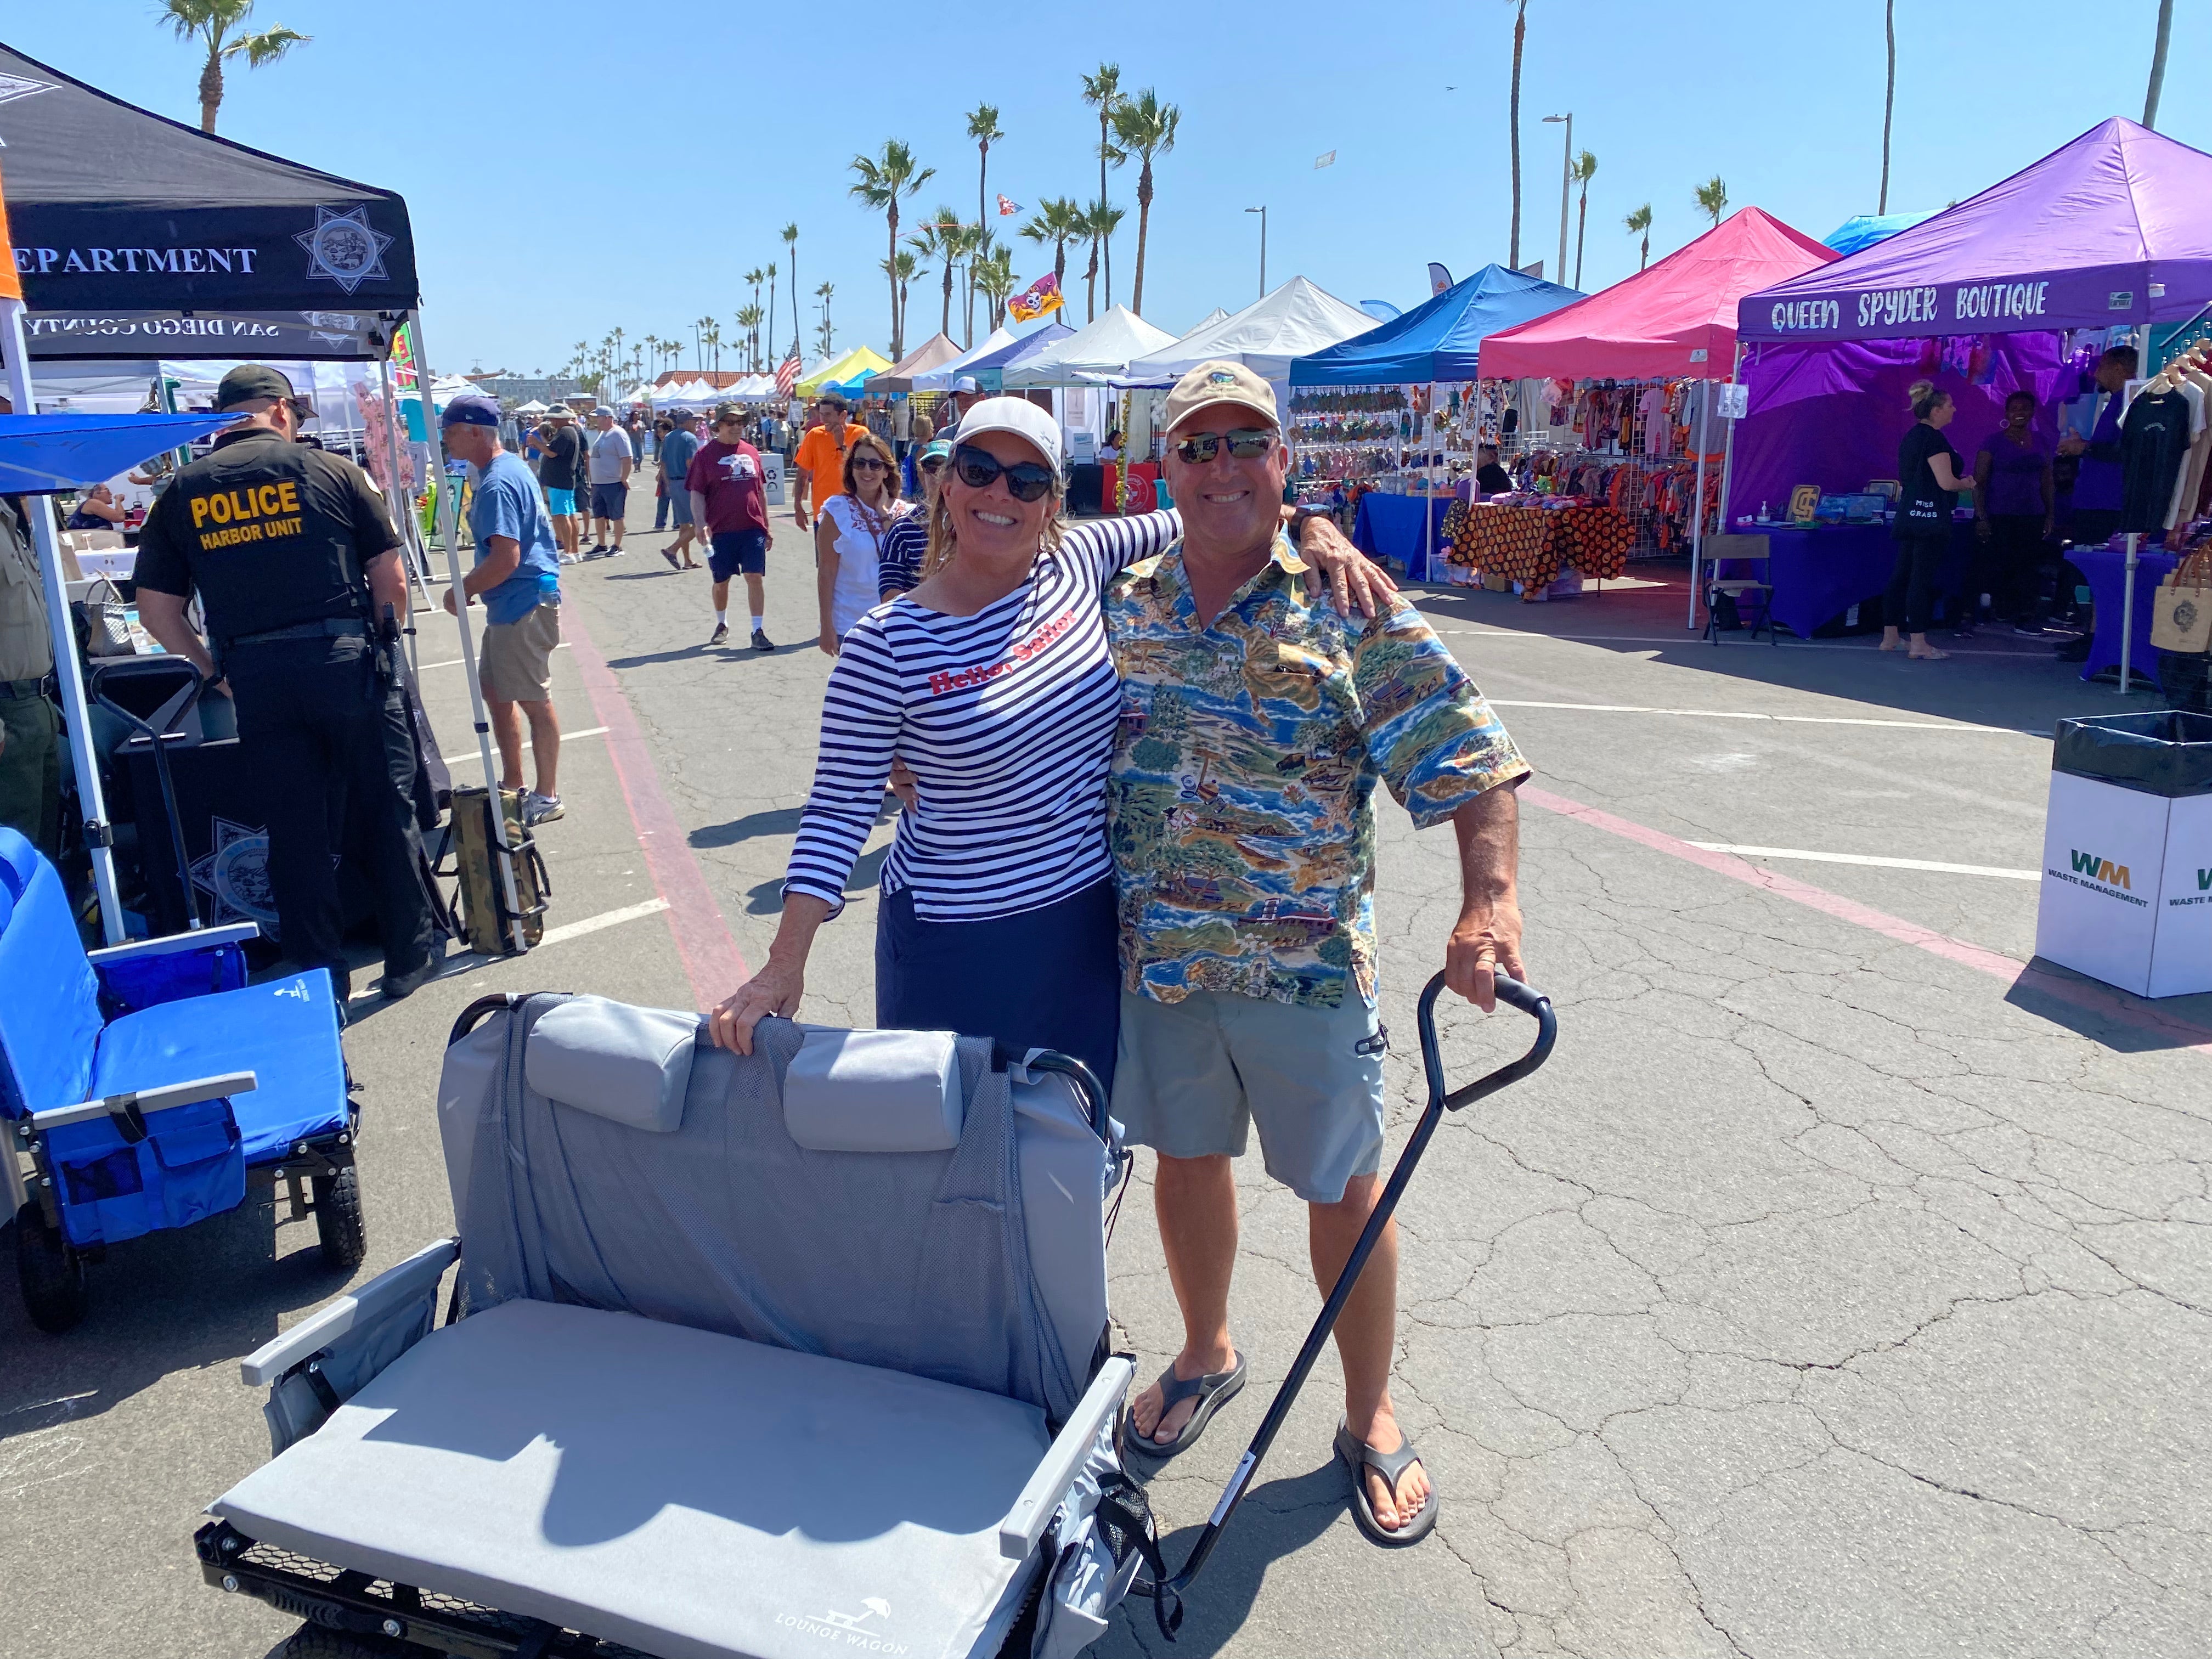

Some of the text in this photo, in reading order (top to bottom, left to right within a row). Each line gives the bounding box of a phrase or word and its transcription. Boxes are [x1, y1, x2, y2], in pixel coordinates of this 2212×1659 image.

[12, 247, 257, 273] EPARTMENT
[1771, 281, 2049, 332] QUEEN SPYDER BOUTIQUE
[190, 482, 300, 528] POLICE
[200, 517, 301, 550] HARBOR UNIT
[928, 610, 1076, 695] Hello, Sailor
[2049, 868, 2148, 907] WASTE MANAGEMENT
[2071, 849, 2130, 890] WM
[2170, 896, 2205, 906] WASTE
[775, 1612, 909, 1655] LOUNGE WAGON
